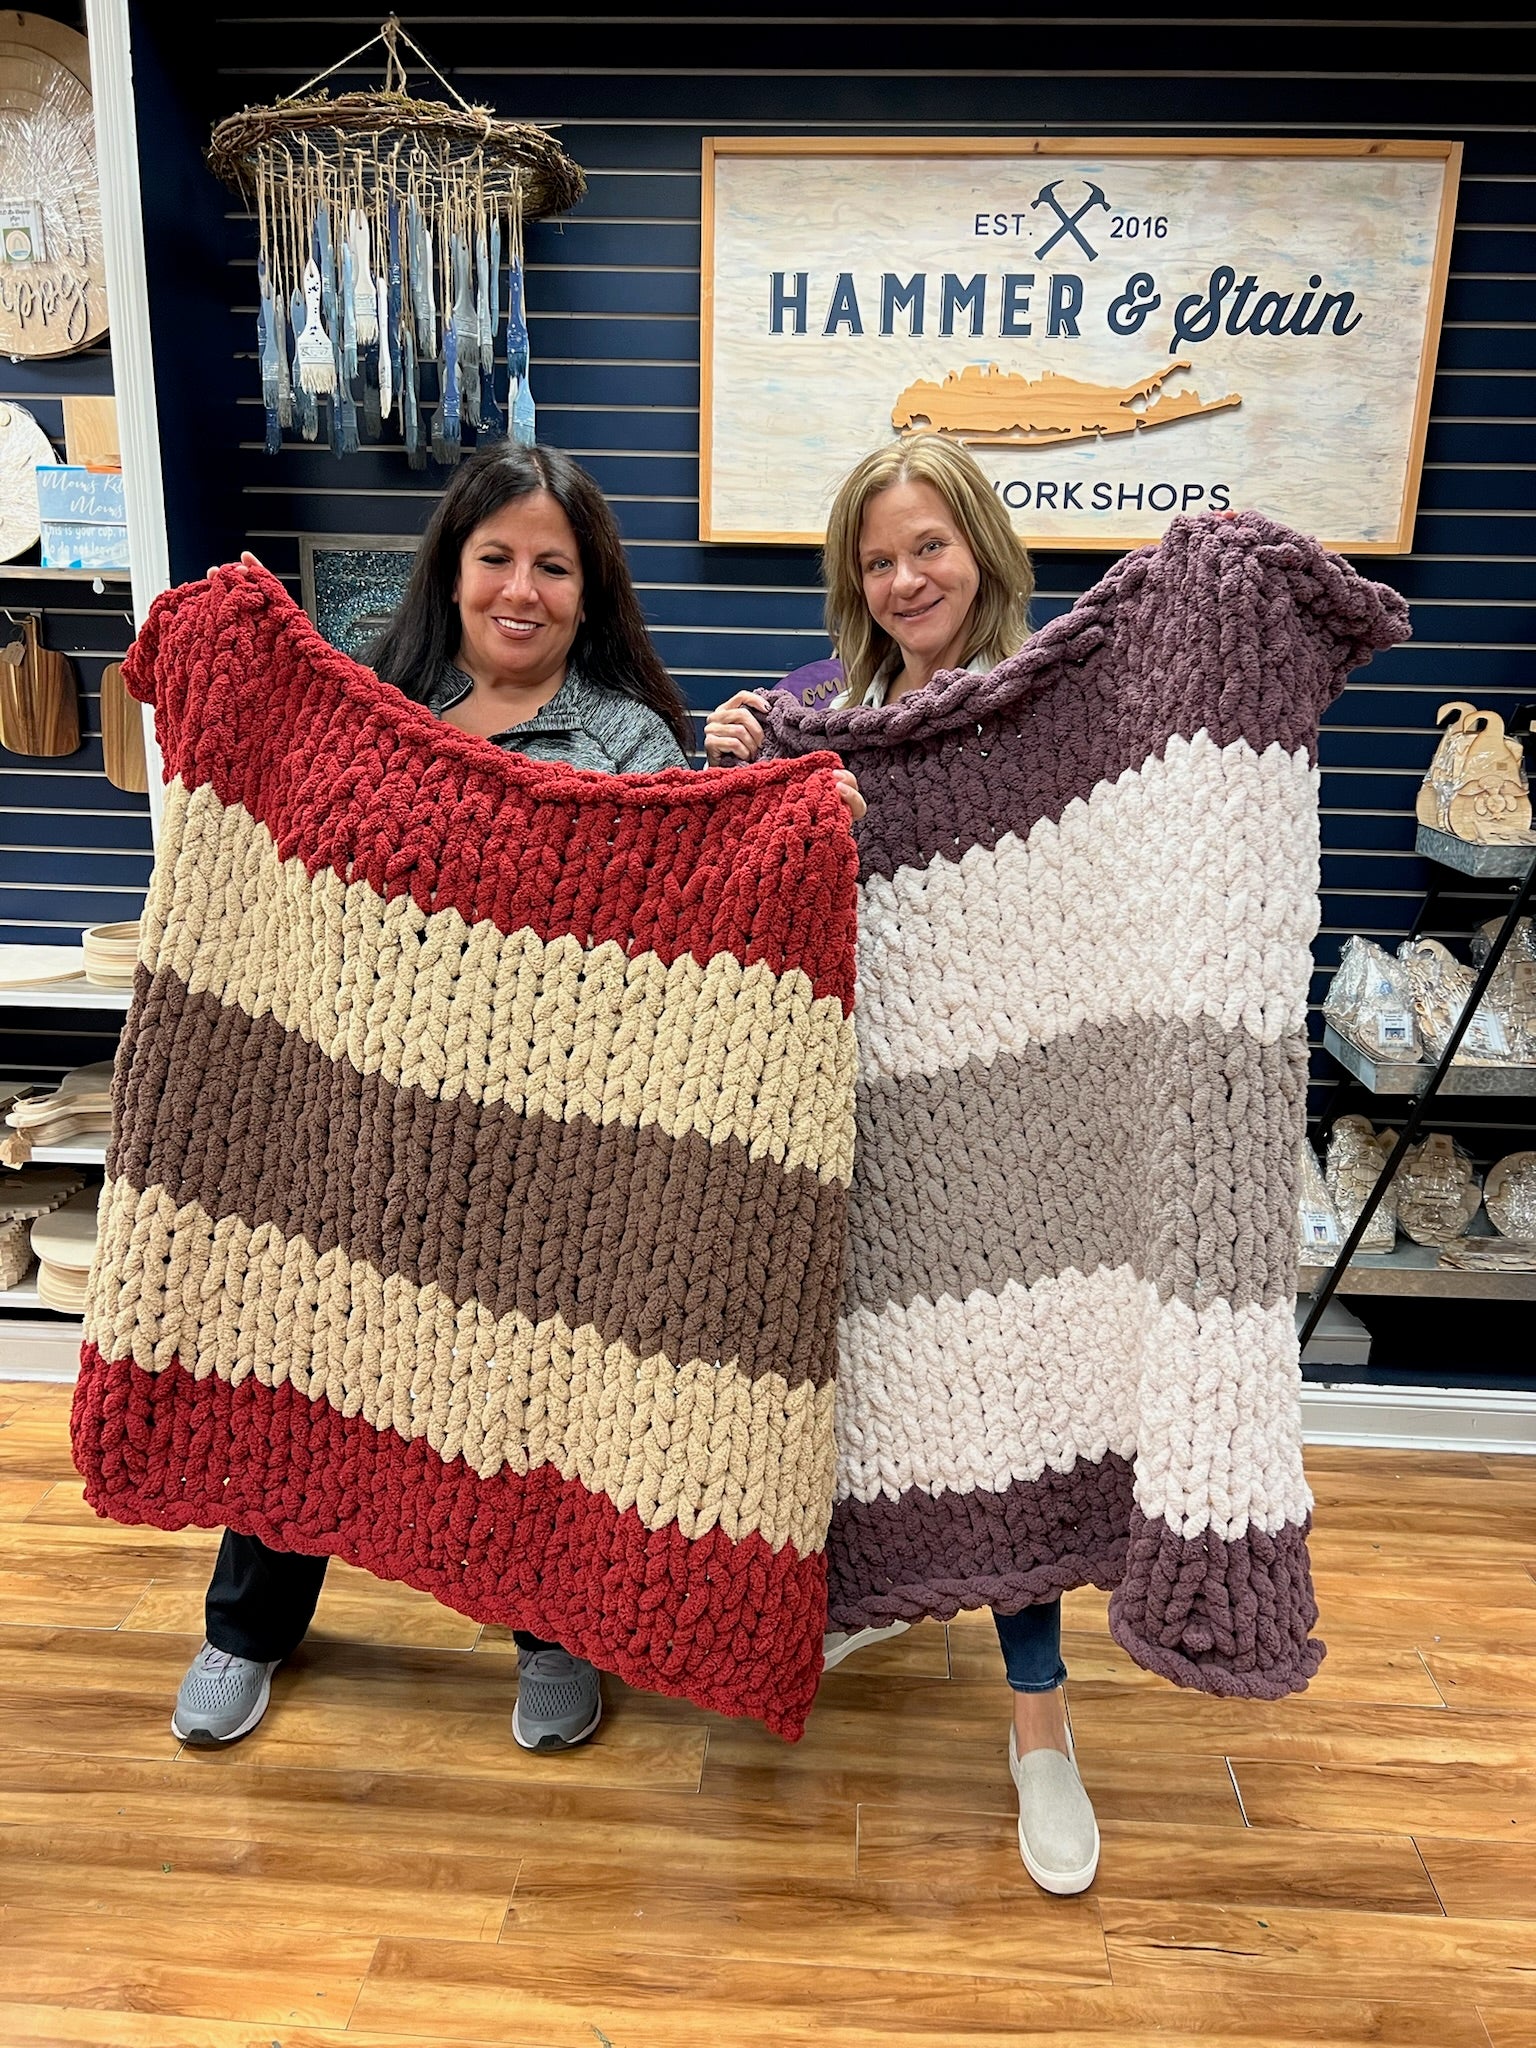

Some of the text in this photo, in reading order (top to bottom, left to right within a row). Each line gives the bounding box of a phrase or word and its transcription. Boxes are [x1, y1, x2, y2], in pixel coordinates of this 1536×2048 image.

[975, 213, 1169, 239] EST. 2016
[769, 265, 1363, 354] HAMMER & Stain
[993, 481, 1231, 511] ORKSHOPS
